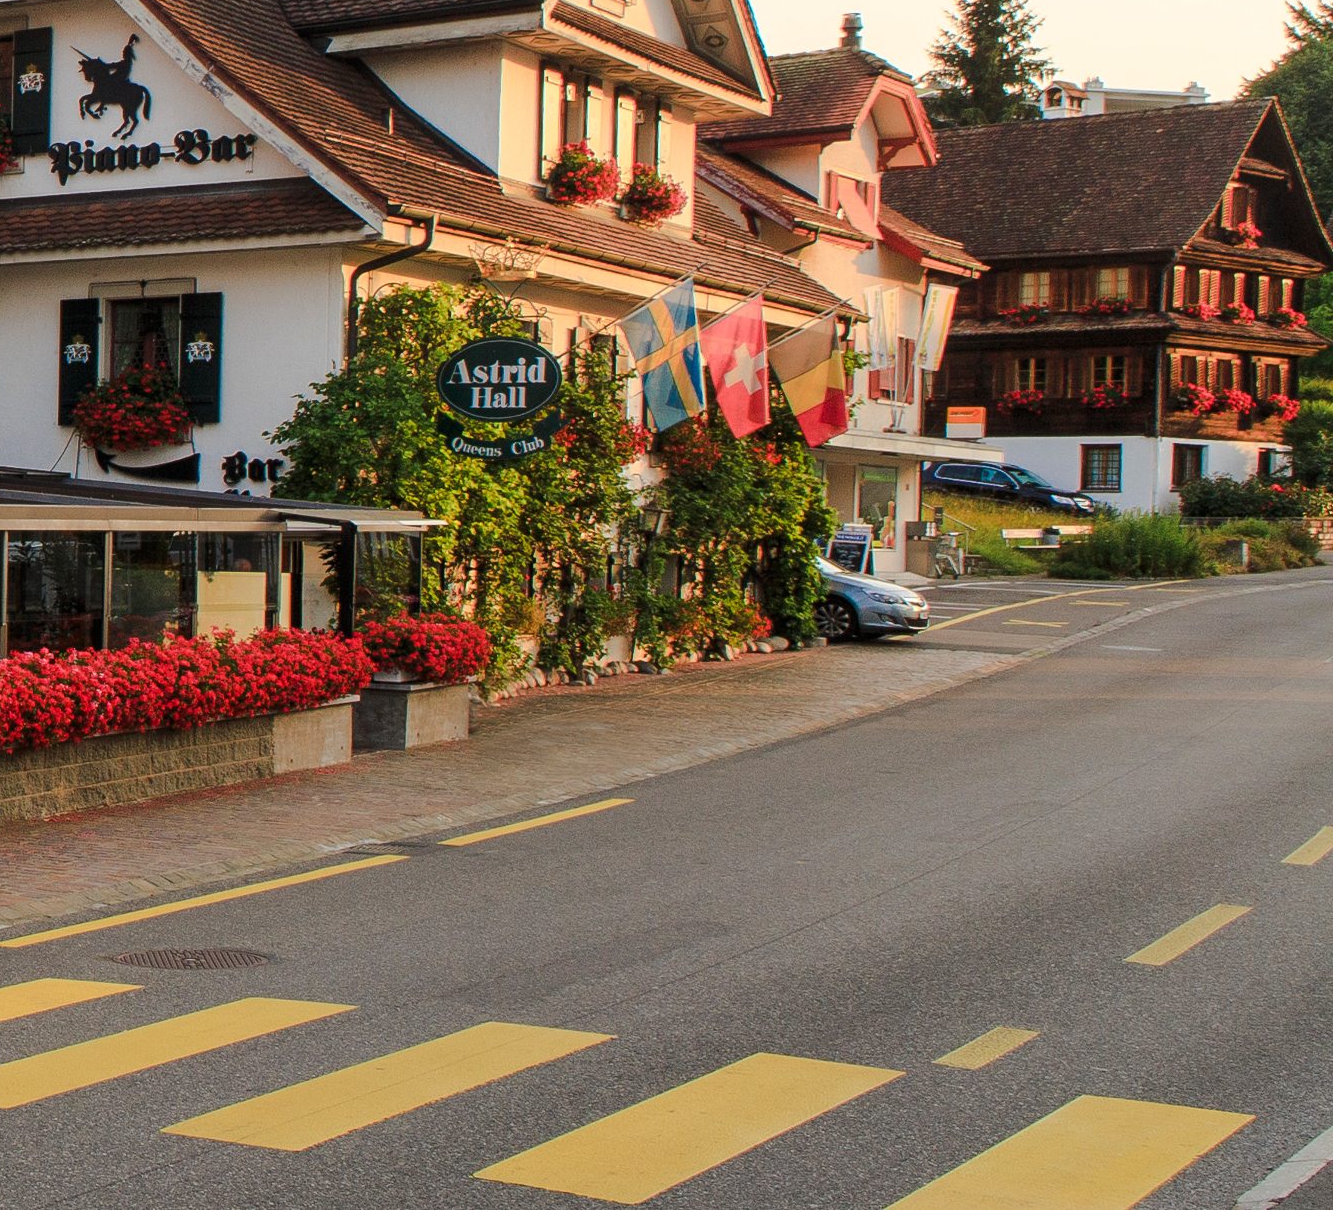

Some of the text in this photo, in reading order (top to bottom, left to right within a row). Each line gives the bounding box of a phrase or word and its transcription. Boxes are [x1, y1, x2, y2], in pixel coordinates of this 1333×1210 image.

[48, 128, 256, 186] Piano-Bar
[445, 356, 547, 385] Astrid
[469, 386, 528, 409] Hall
[451, 436, 545, 458] Queens Club
[221, 450, 285, 486] Bar
